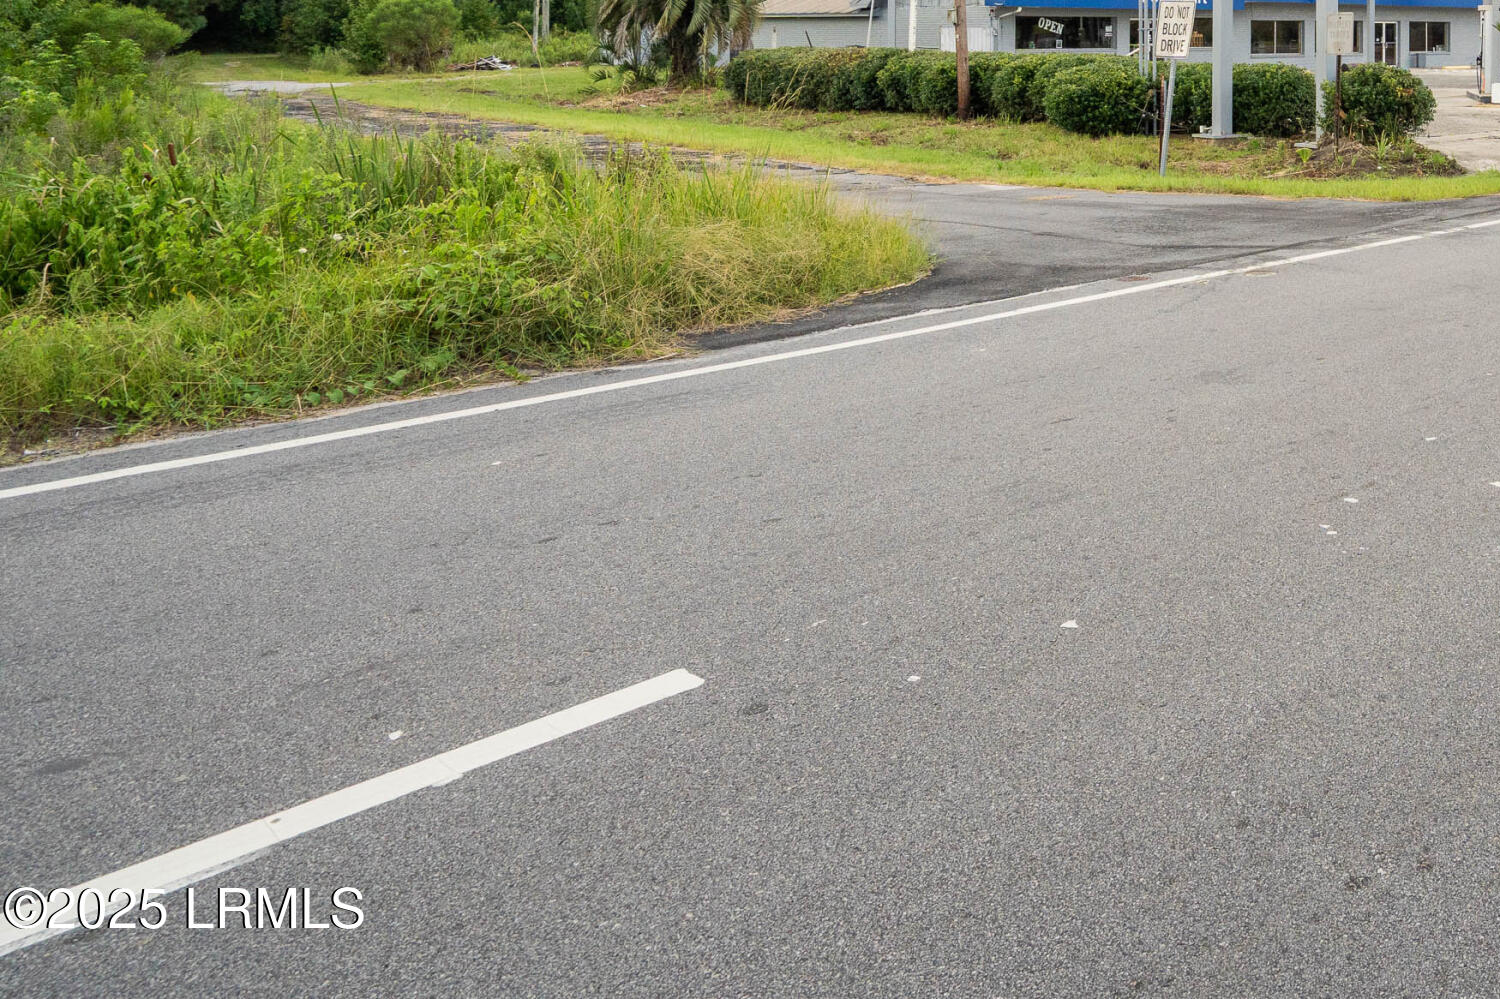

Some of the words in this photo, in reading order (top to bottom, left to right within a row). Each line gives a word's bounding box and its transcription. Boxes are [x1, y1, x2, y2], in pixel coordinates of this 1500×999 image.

[1164, 6, 1174, 19] DO
[1177, 5, 1190, 19] NOT
[1038, 17, 1064, 35] OPEN
[1162, 22, 1188, 36] BLOCK
[1160, 39, 1186, 53] DRIVE
